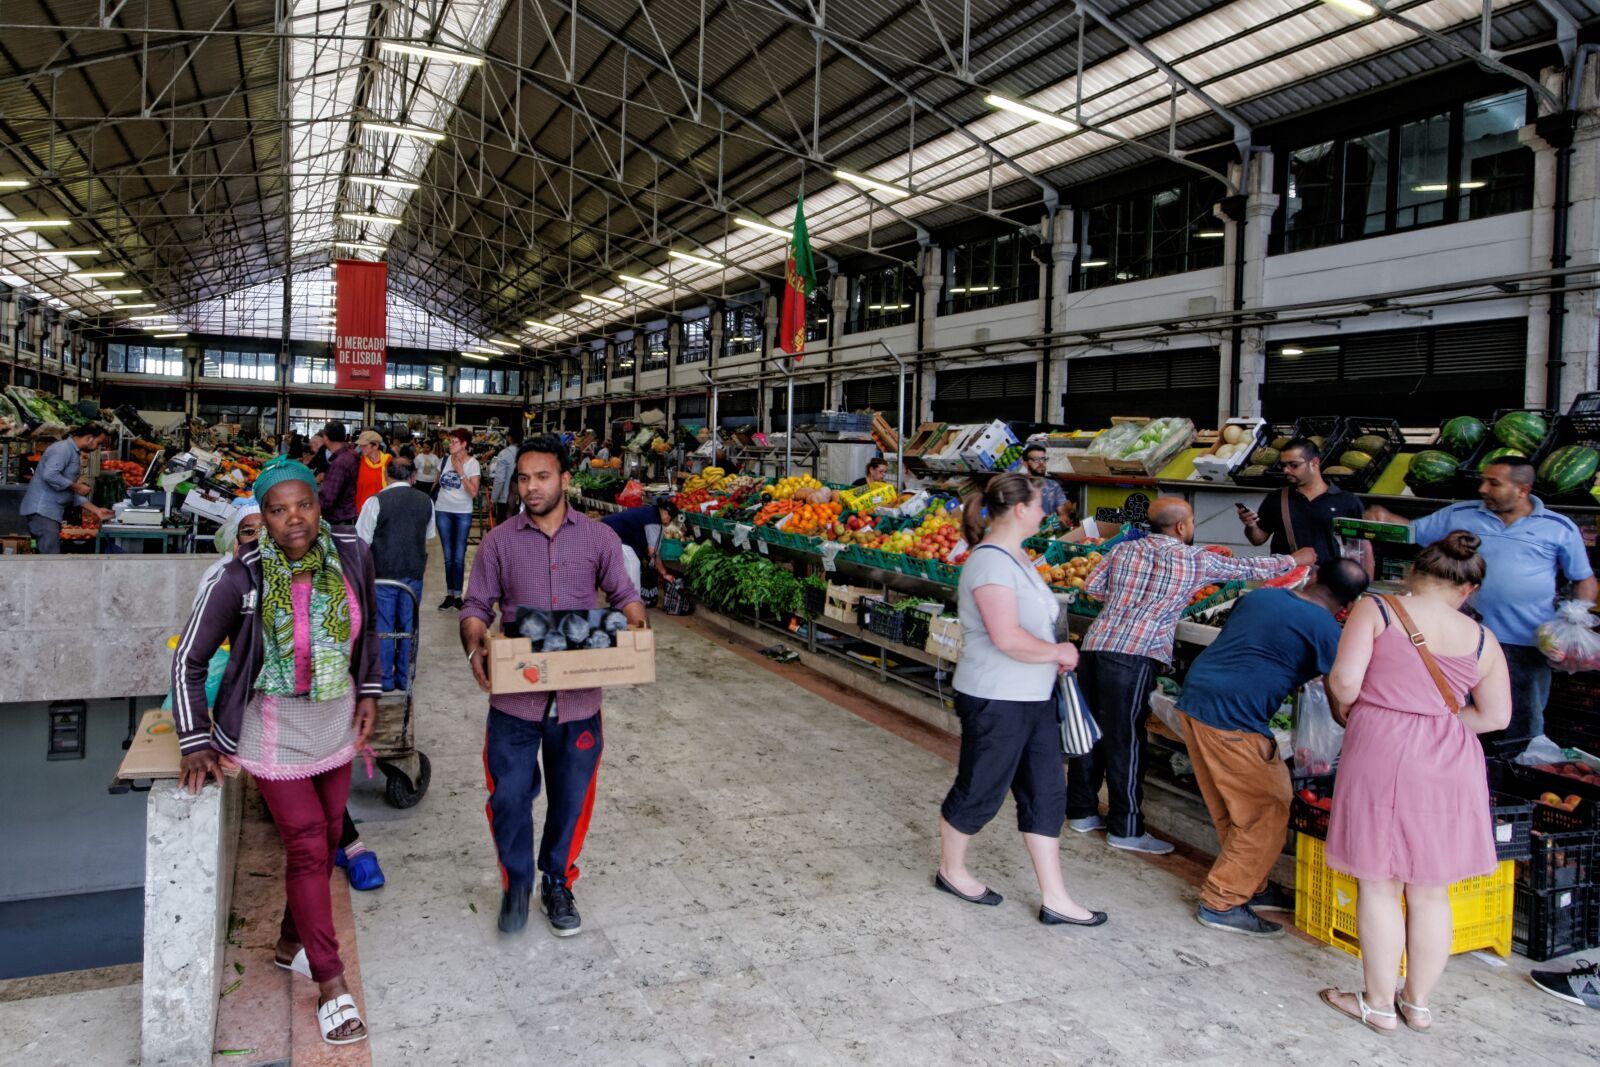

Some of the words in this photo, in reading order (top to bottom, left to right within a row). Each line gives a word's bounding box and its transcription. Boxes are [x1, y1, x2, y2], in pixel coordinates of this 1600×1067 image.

[337, 336, 342, 348] O
[345, 336, 385, 351] MERCADO
[339, 351, 350, 364] DE
[352, 351, 382, 365] LISBOA
